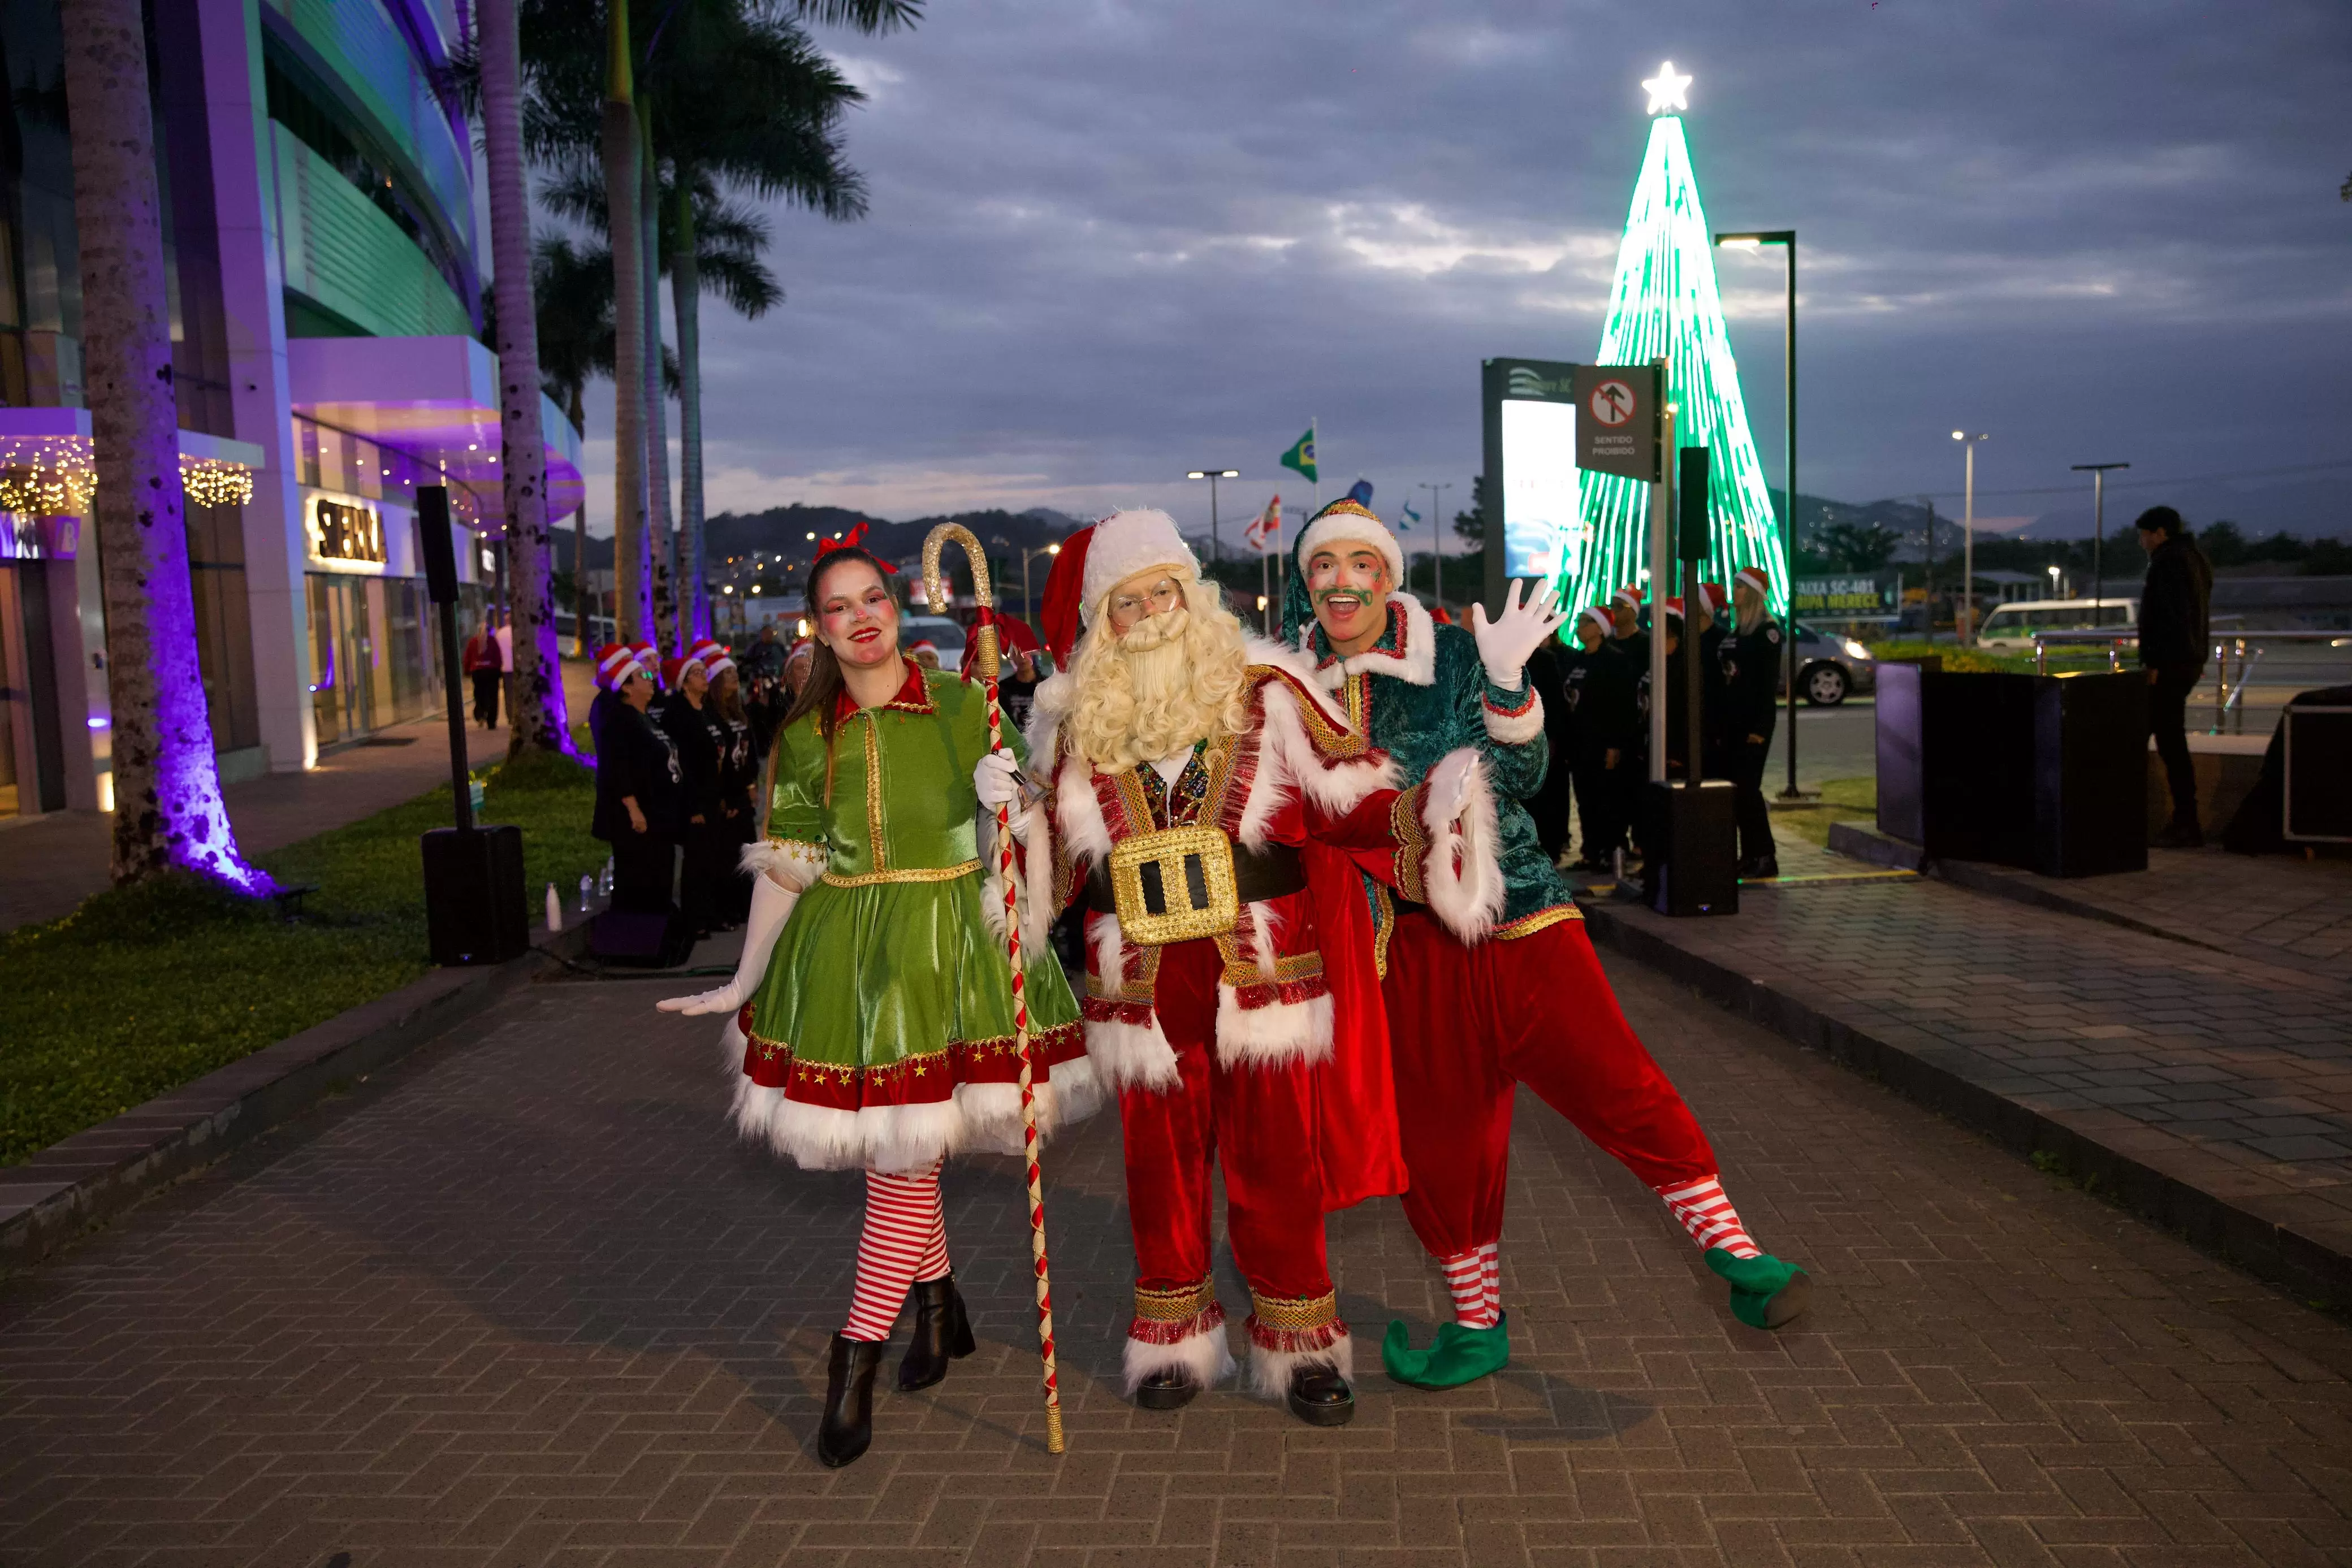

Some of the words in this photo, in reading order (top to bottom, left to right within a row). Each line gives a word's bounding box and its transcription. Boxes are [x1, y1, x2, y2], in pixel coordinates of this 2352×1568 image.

[1594, 435, 1633, 444] SENTIDO
[1592, 447, 1635, 456] PROIBIDO
[1827, 593, 1880, 609] MERECE
